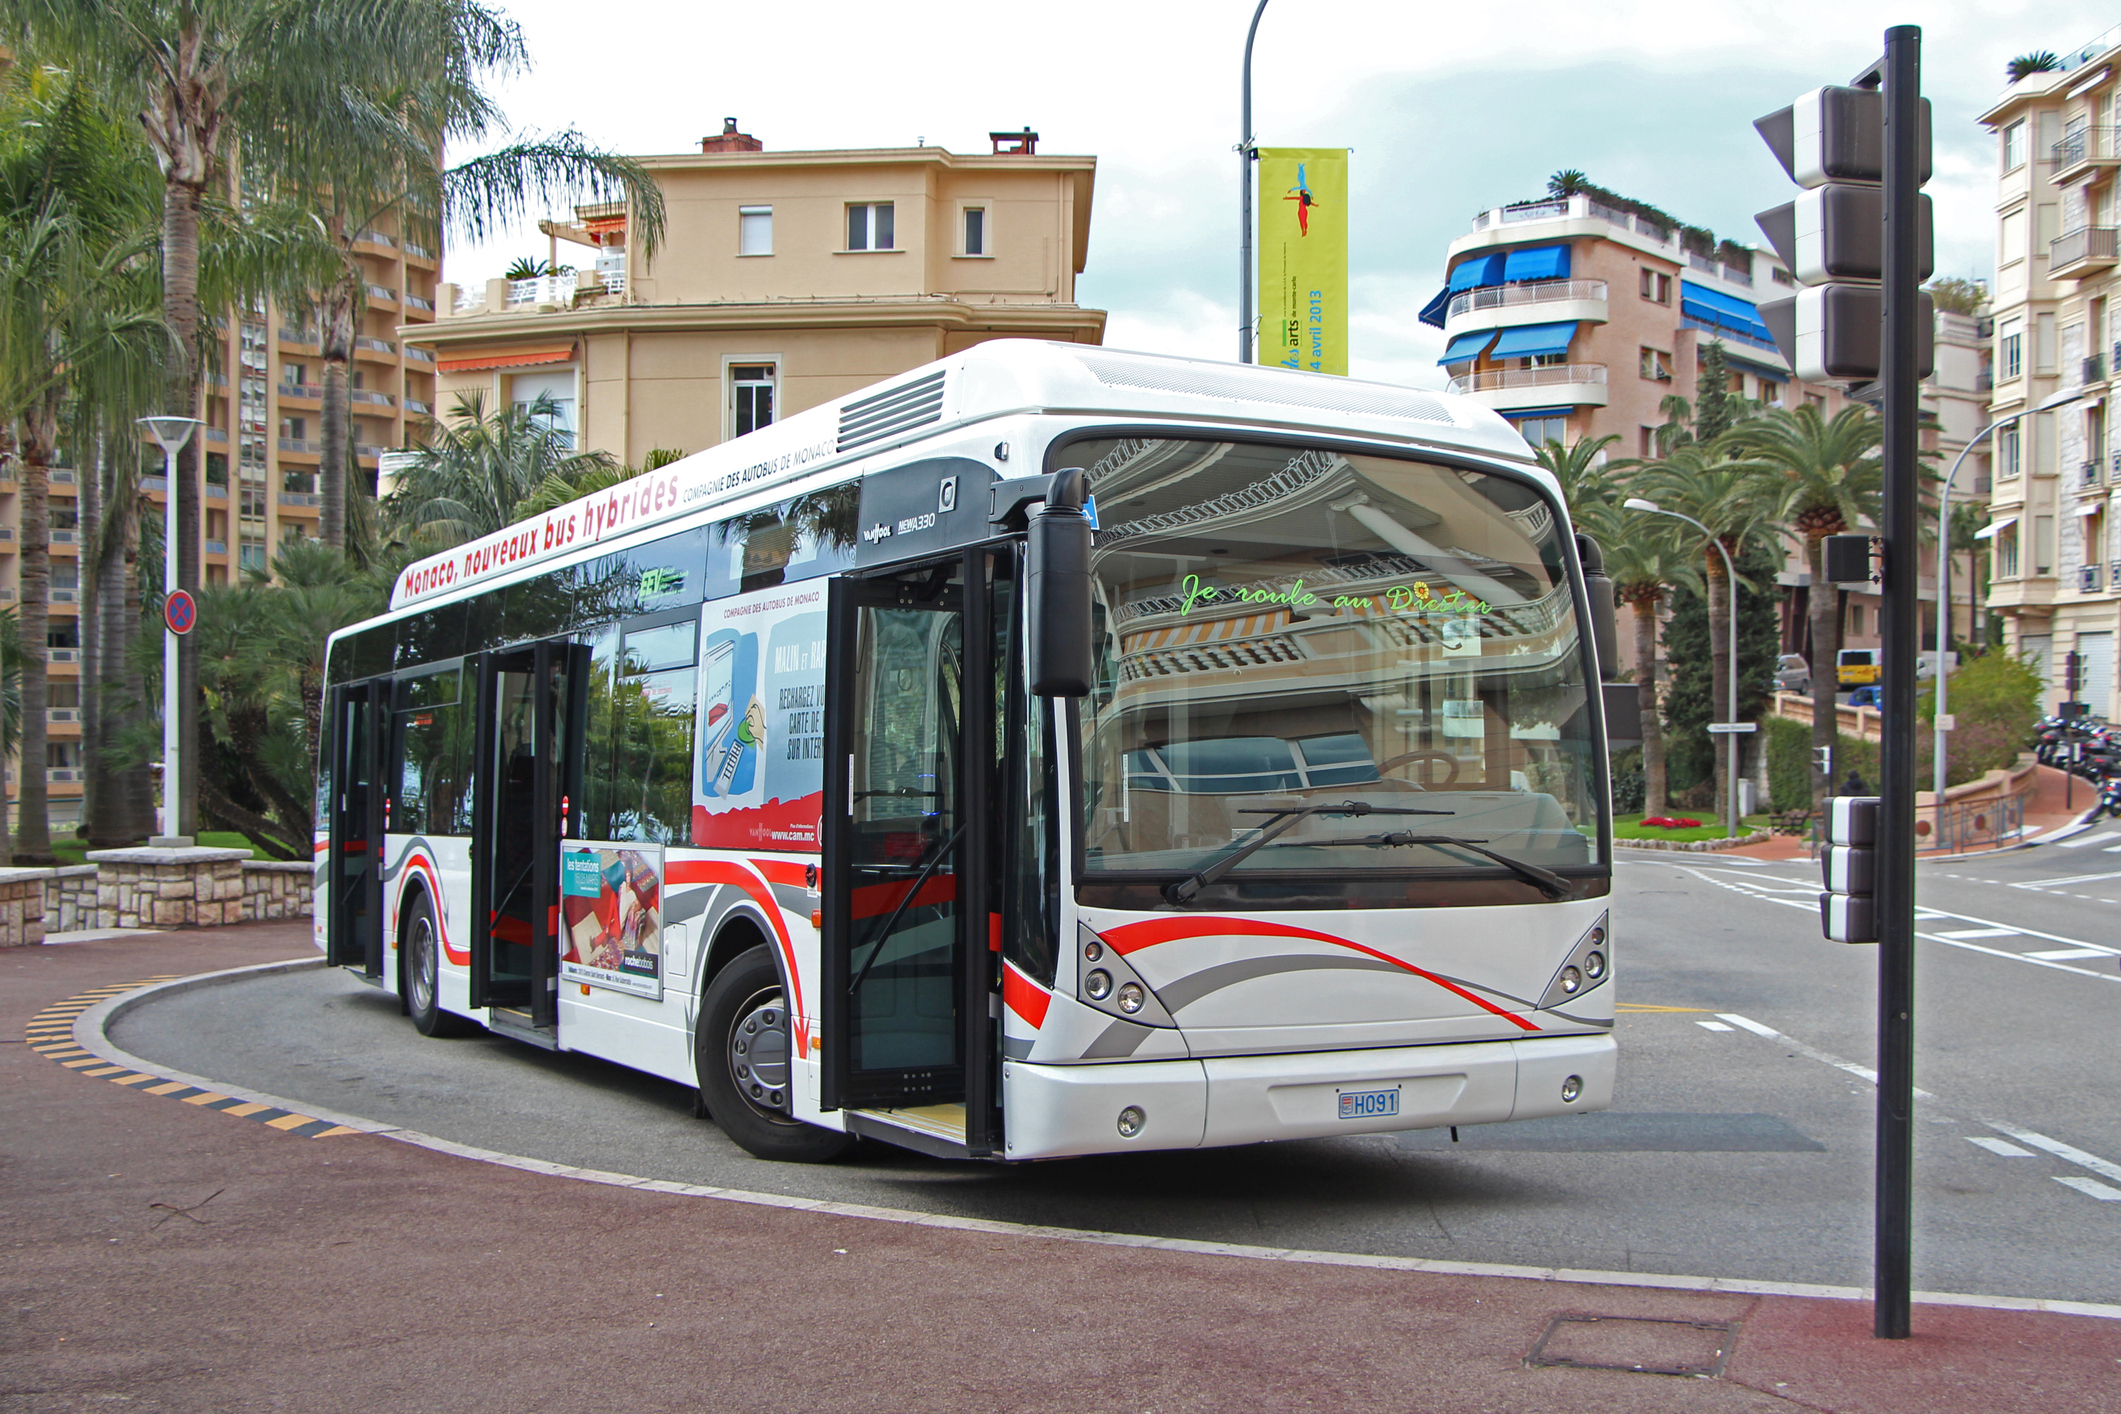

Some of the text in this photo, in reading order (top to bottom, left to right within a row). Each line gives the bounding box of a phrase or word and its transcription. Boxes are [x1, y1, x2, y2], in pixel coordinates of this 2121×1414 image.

[1309, 290, 1322, 323] 2013
[1288, 320, 1299, 347] arts
[1309, 327, 1322, 357] avril
[683, 439, 835, 503] COMPAGNIE DES AUTOBUS DE MONACO
[404, 474, 678, 598] Monaco, nouveaux bus hybrides
[640, 568, 663, 597] EEV
[1180, 574, 1493, 616] Je roule au Diester
[723, 591, 820, 619] COMPAGNIE DES AUTOBUS DE MONACO
[774, 643, 799, 674] MALIN
[801, 652, 808, 670] ET
[779, 685, 814, 710] RECHARGEZ
[788, 711, 809, 734] CARTE
[811, 711, 820, 734] DE
[787, 737, 800, 760] SUR
[771, 830, 815, 842] www.cam.mc
[575, 859, 599, 873] tentations
[1355, 1093, 1394, 1114] H091
